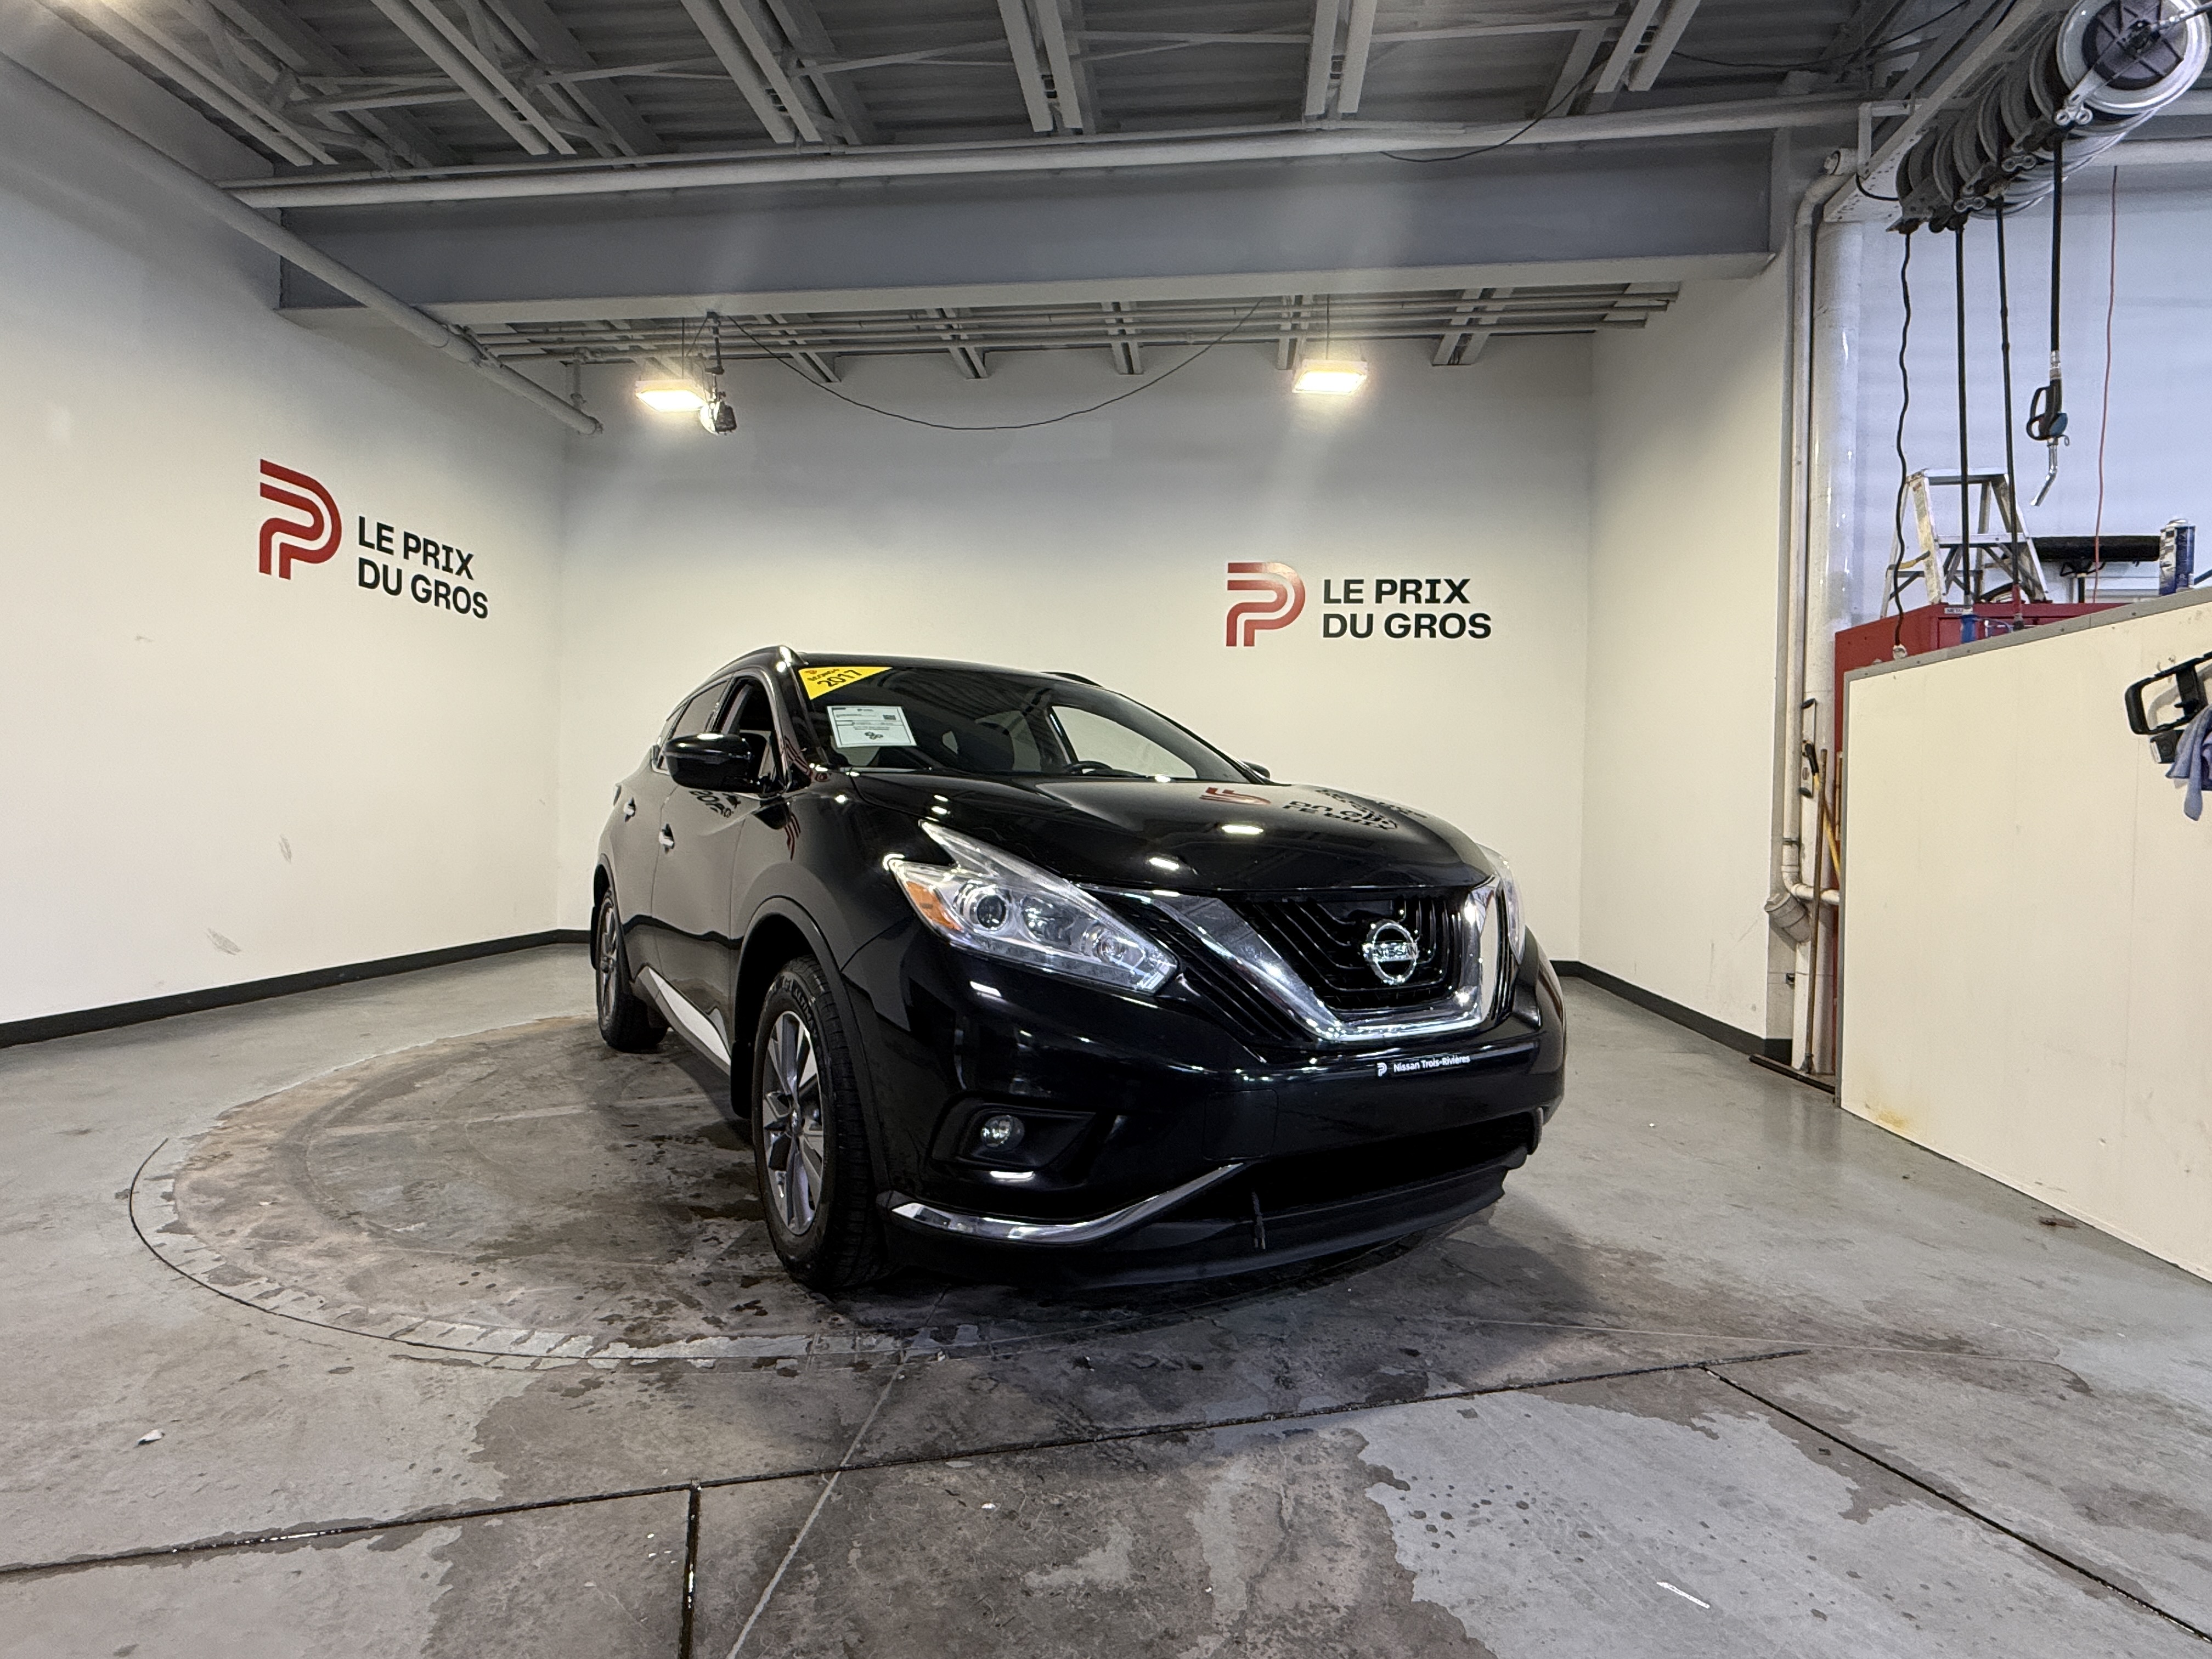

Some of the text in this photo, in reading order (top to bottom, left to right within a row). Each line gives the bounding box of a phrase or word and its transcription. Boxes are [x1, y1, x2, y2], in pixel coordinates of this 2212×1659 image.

[359, 516, 475, 580] LE PRIX
[358, 557, 488, 619] DU GROS
[1323, 578, 1471, 603] LE PRIX
[1323, 612, 1491, 639] DU GROS
[817, 669, 862, 687] 2017
[1393, 1054, 1470, 1073] Nissan Trois-Rivières
